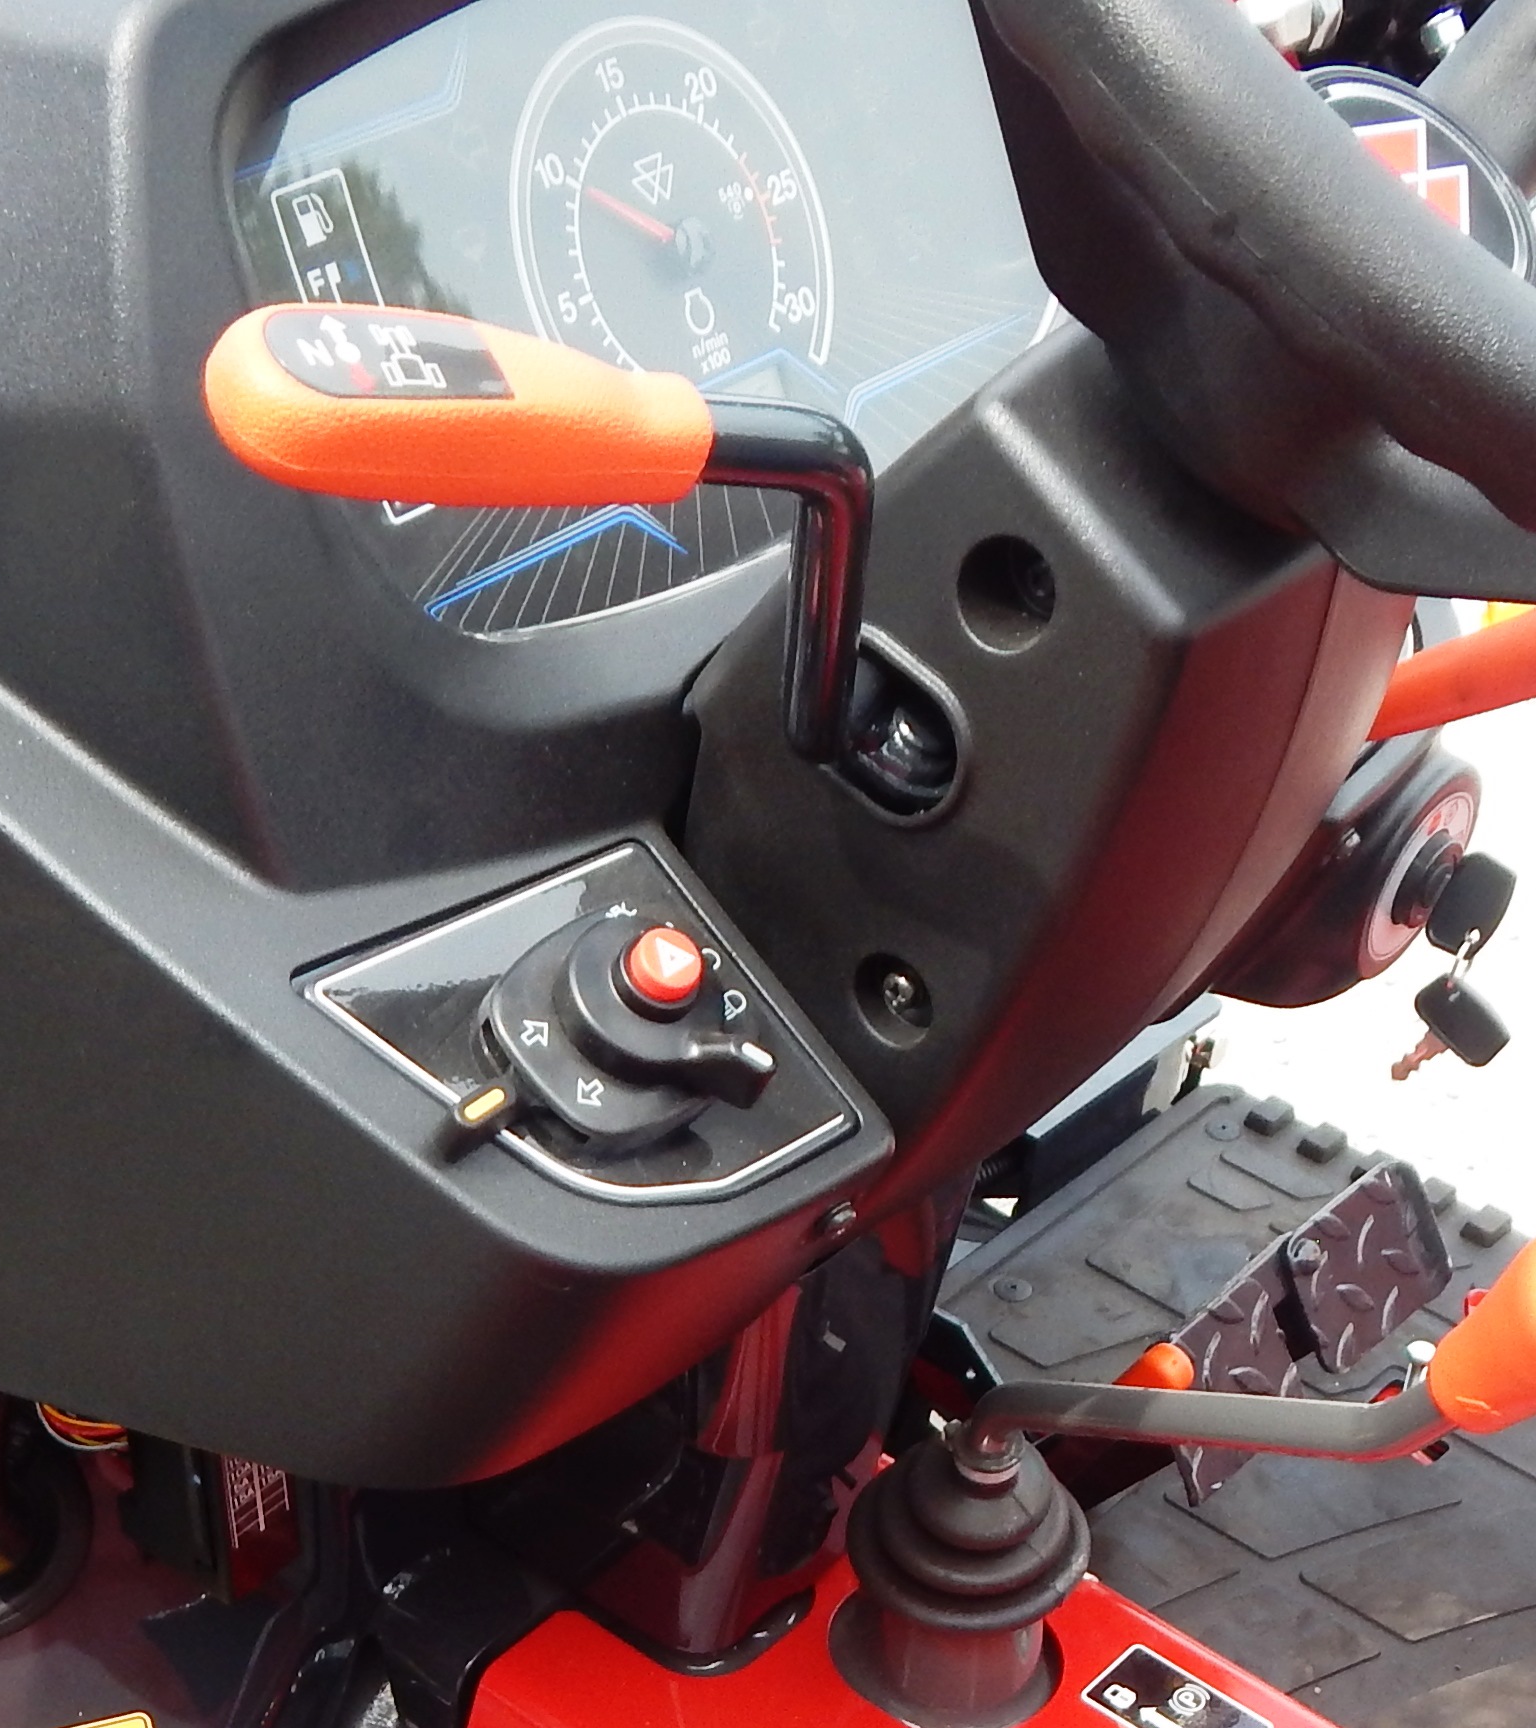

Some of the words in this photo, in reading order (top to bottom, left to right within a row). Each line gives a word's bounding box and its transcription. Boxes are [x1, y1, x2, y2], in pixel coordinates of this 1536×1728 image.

[595, 57, 625, 93] 15
[684, 66, 717, 103] 20
[534, 152, 565, 188] 10
[767, 169, 798, 206] 25
[557, 291, 578, 324] 5
[784, 286, 816, 323] 30
[692, 331, 729, 360] n/min
[700, 347, 731, 375] x100
